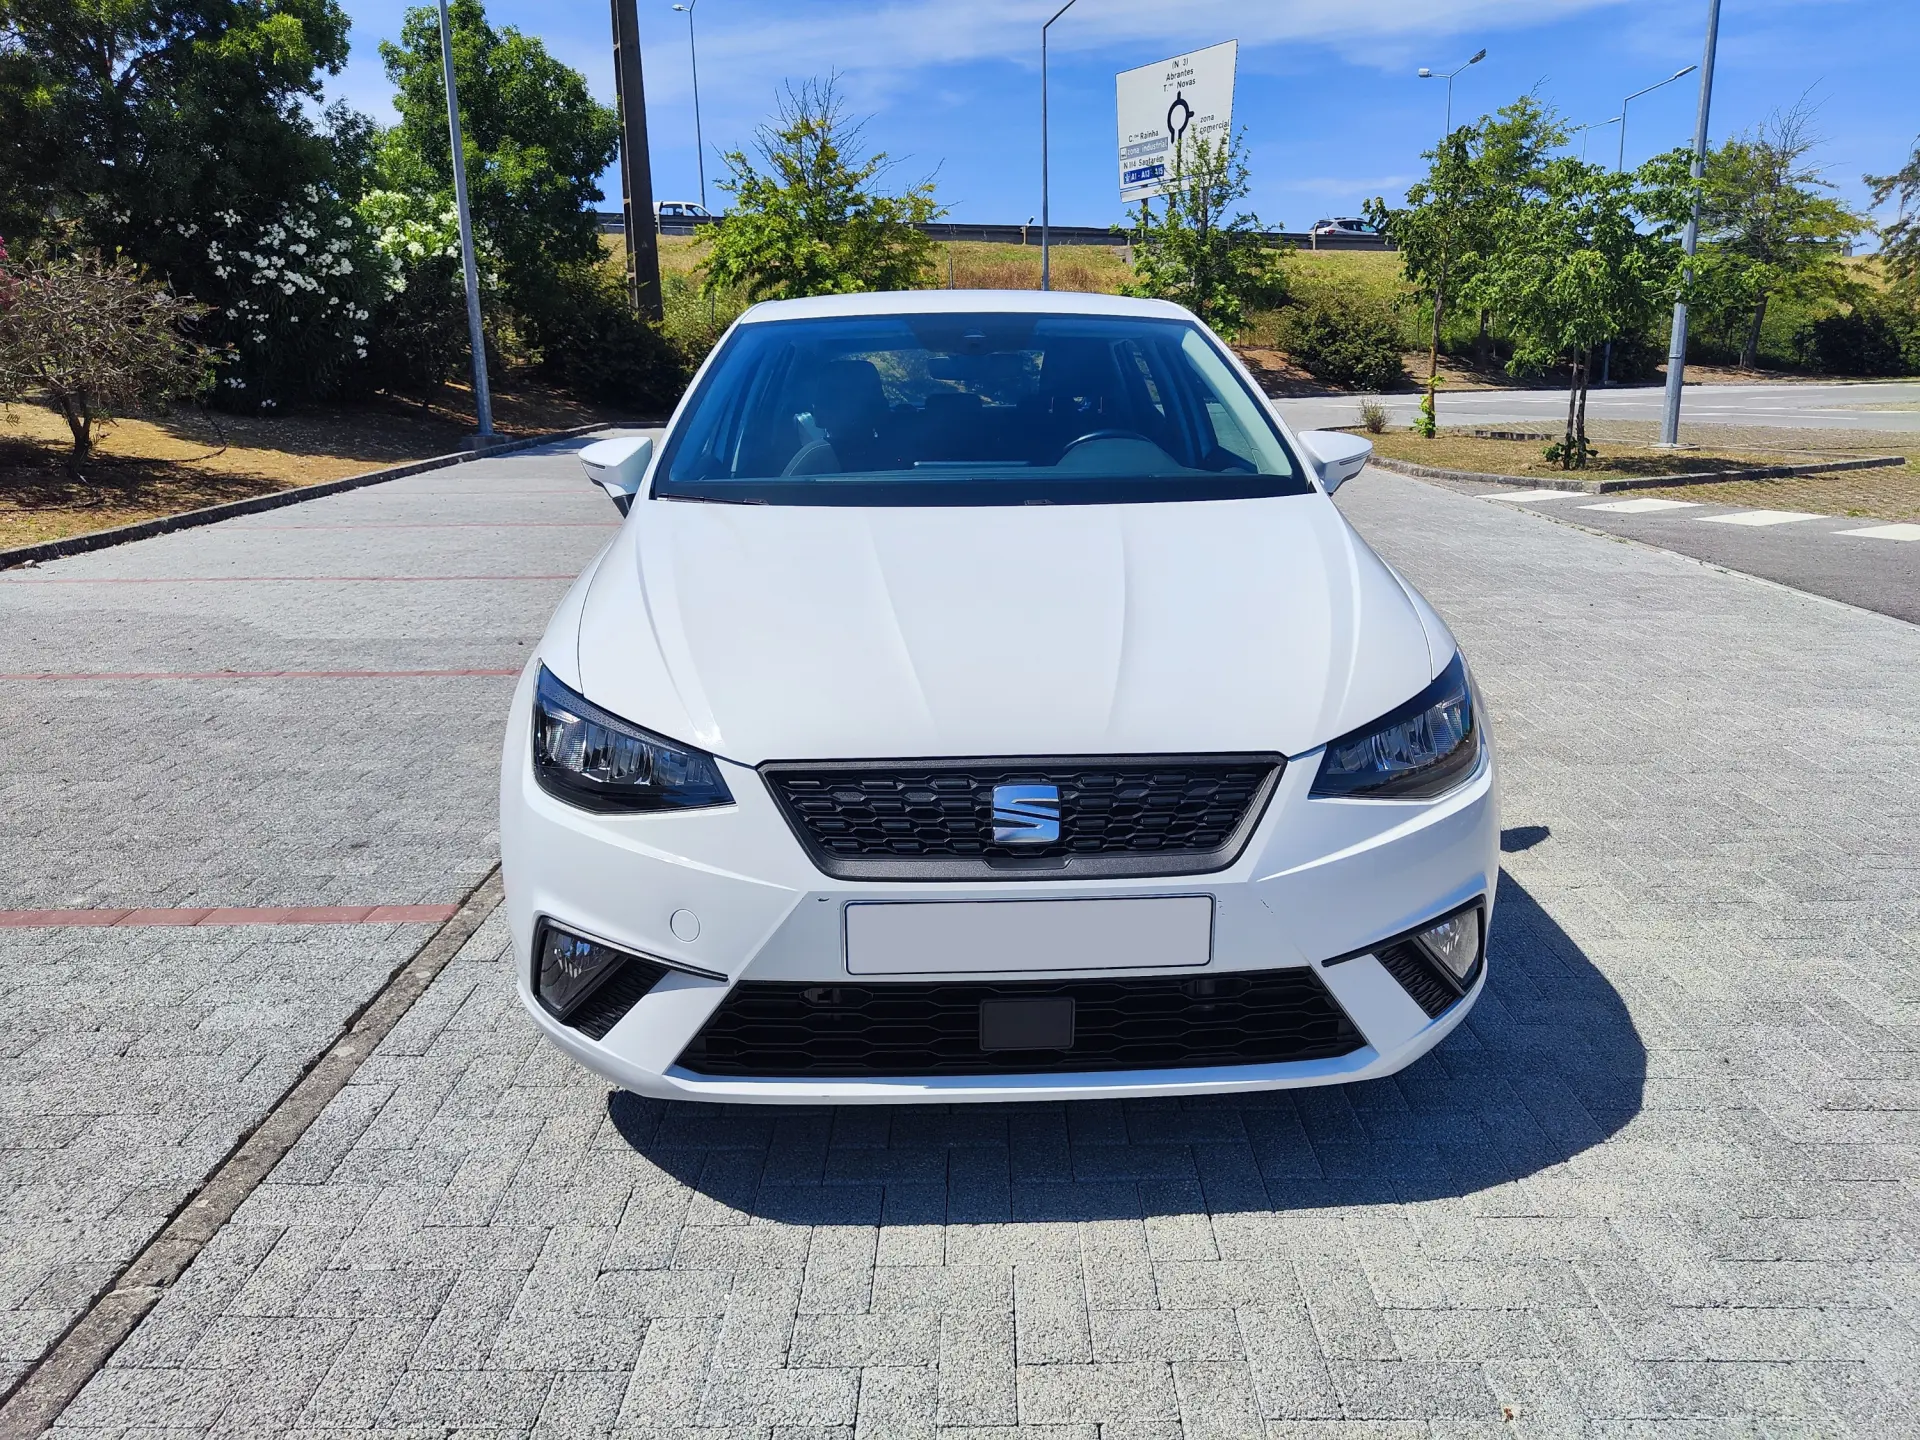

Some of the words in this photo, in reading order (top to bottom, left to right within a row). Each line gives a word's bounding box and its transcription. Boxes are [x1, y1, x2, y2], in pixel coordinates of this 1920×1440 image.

[1166, 68, 1194, 81] Abrantes
[1177, 78, 1196, 89] Novas
[1200, 114, 1215, 123] zona
[1200, 119, 1229, 135] comercial
[1140, 130, 1158, 140] Rainha
[1127, 147, 1140, 156] zona
[1141, 138, 1167, 153] industrial
